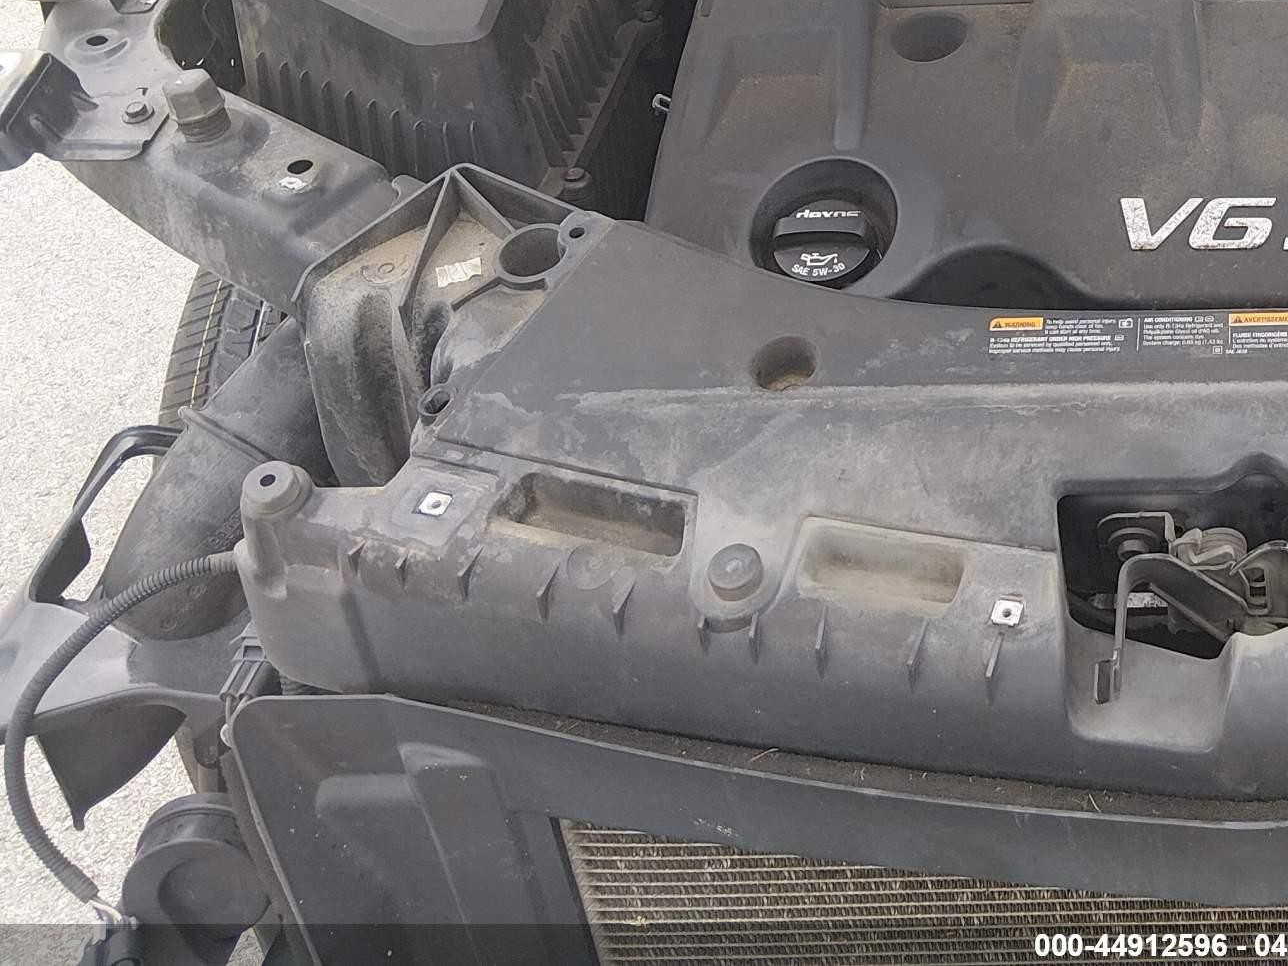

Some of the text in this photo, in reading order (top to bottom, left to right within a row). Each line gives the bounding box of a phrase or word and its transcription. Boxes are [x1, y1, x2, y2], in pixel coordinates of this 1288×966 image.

[1119, 197, 1277, 250] V6
[791, 262, 846, 277] SAE 5W-30
